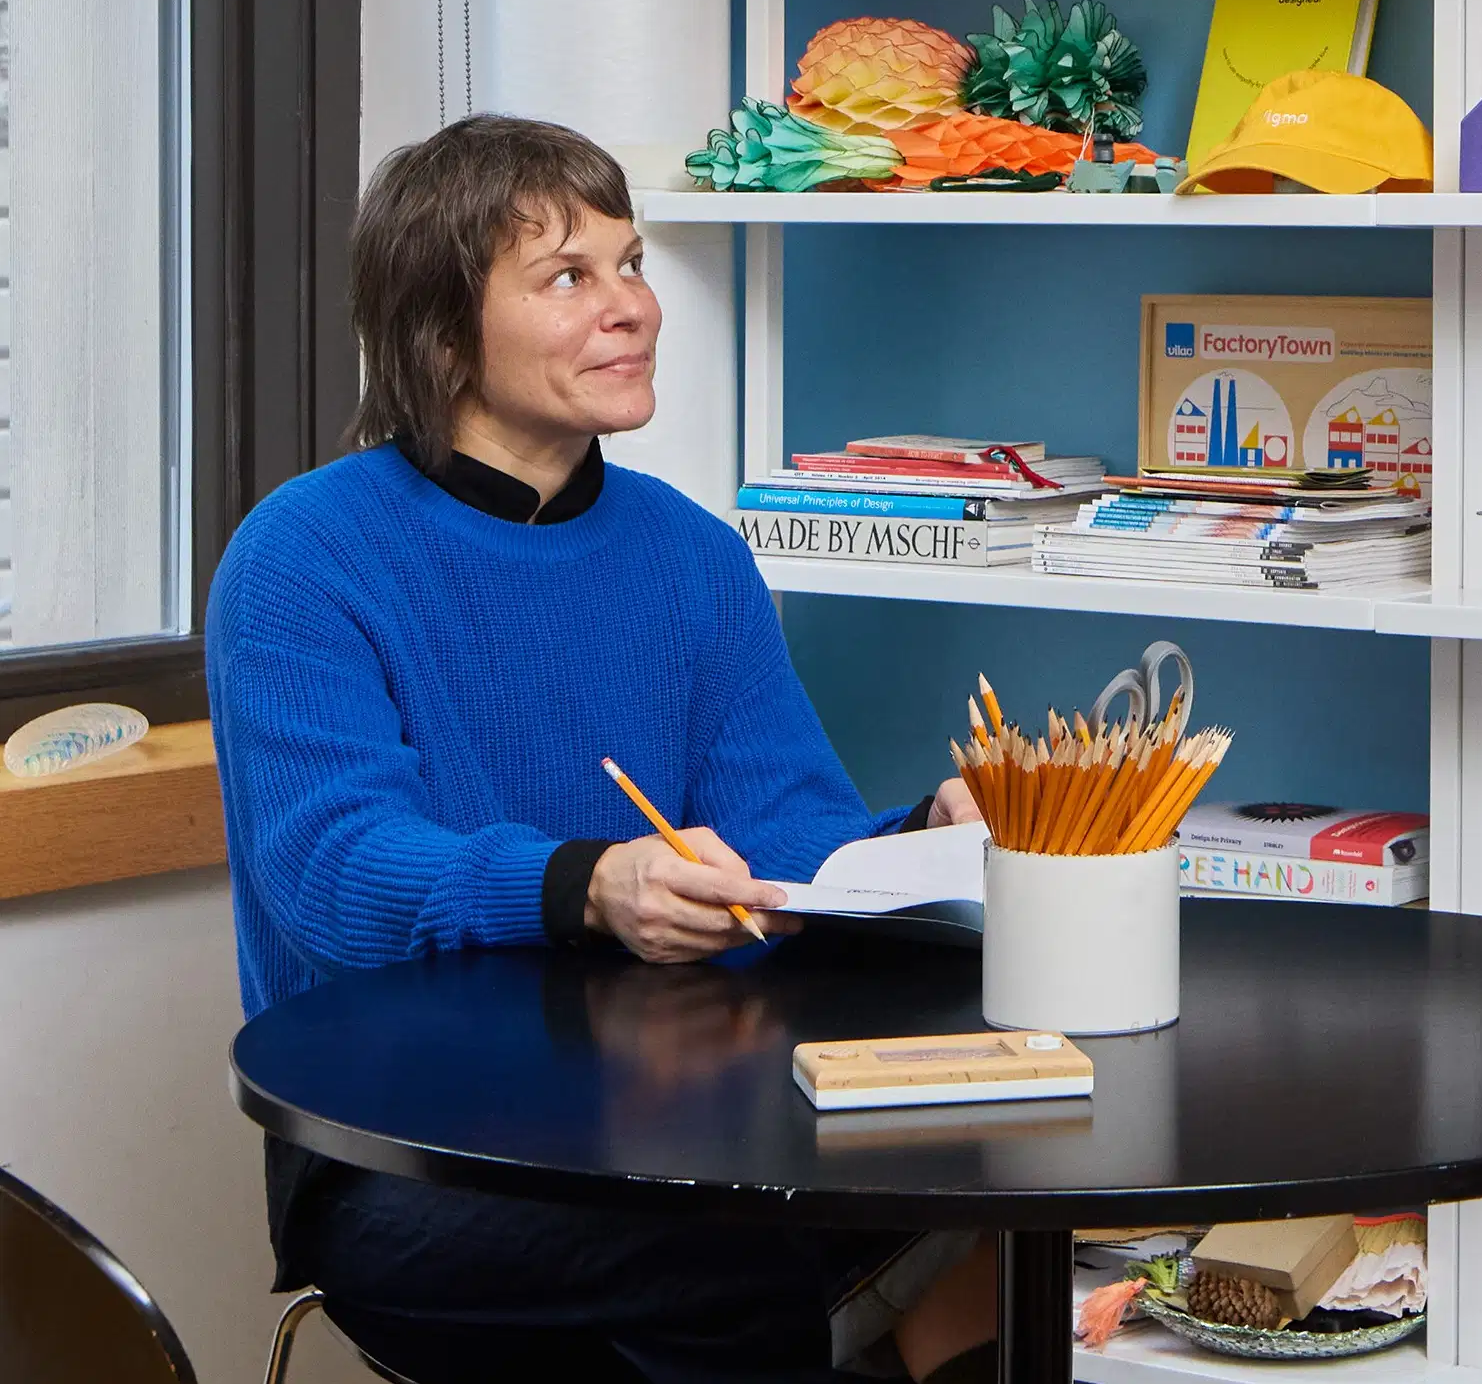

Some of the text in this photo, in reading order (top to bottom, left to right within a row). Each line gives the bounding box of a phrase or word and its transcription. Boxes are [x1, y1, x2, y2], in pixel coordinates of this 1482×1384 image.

[1167, 346, 1193, 357] vilac
[1203, 333, 1332, 358] FactoryTown
[759, 493, 800, 506] Universal
[803, 495, 848, 509] Principles
[850, 497, 861, 508] of
[863, 498, 894, 512] Design
[738, 516, 965, 559] MADE BY MSCHF
[1191, 833, 1242, 846] Design for Privacy
